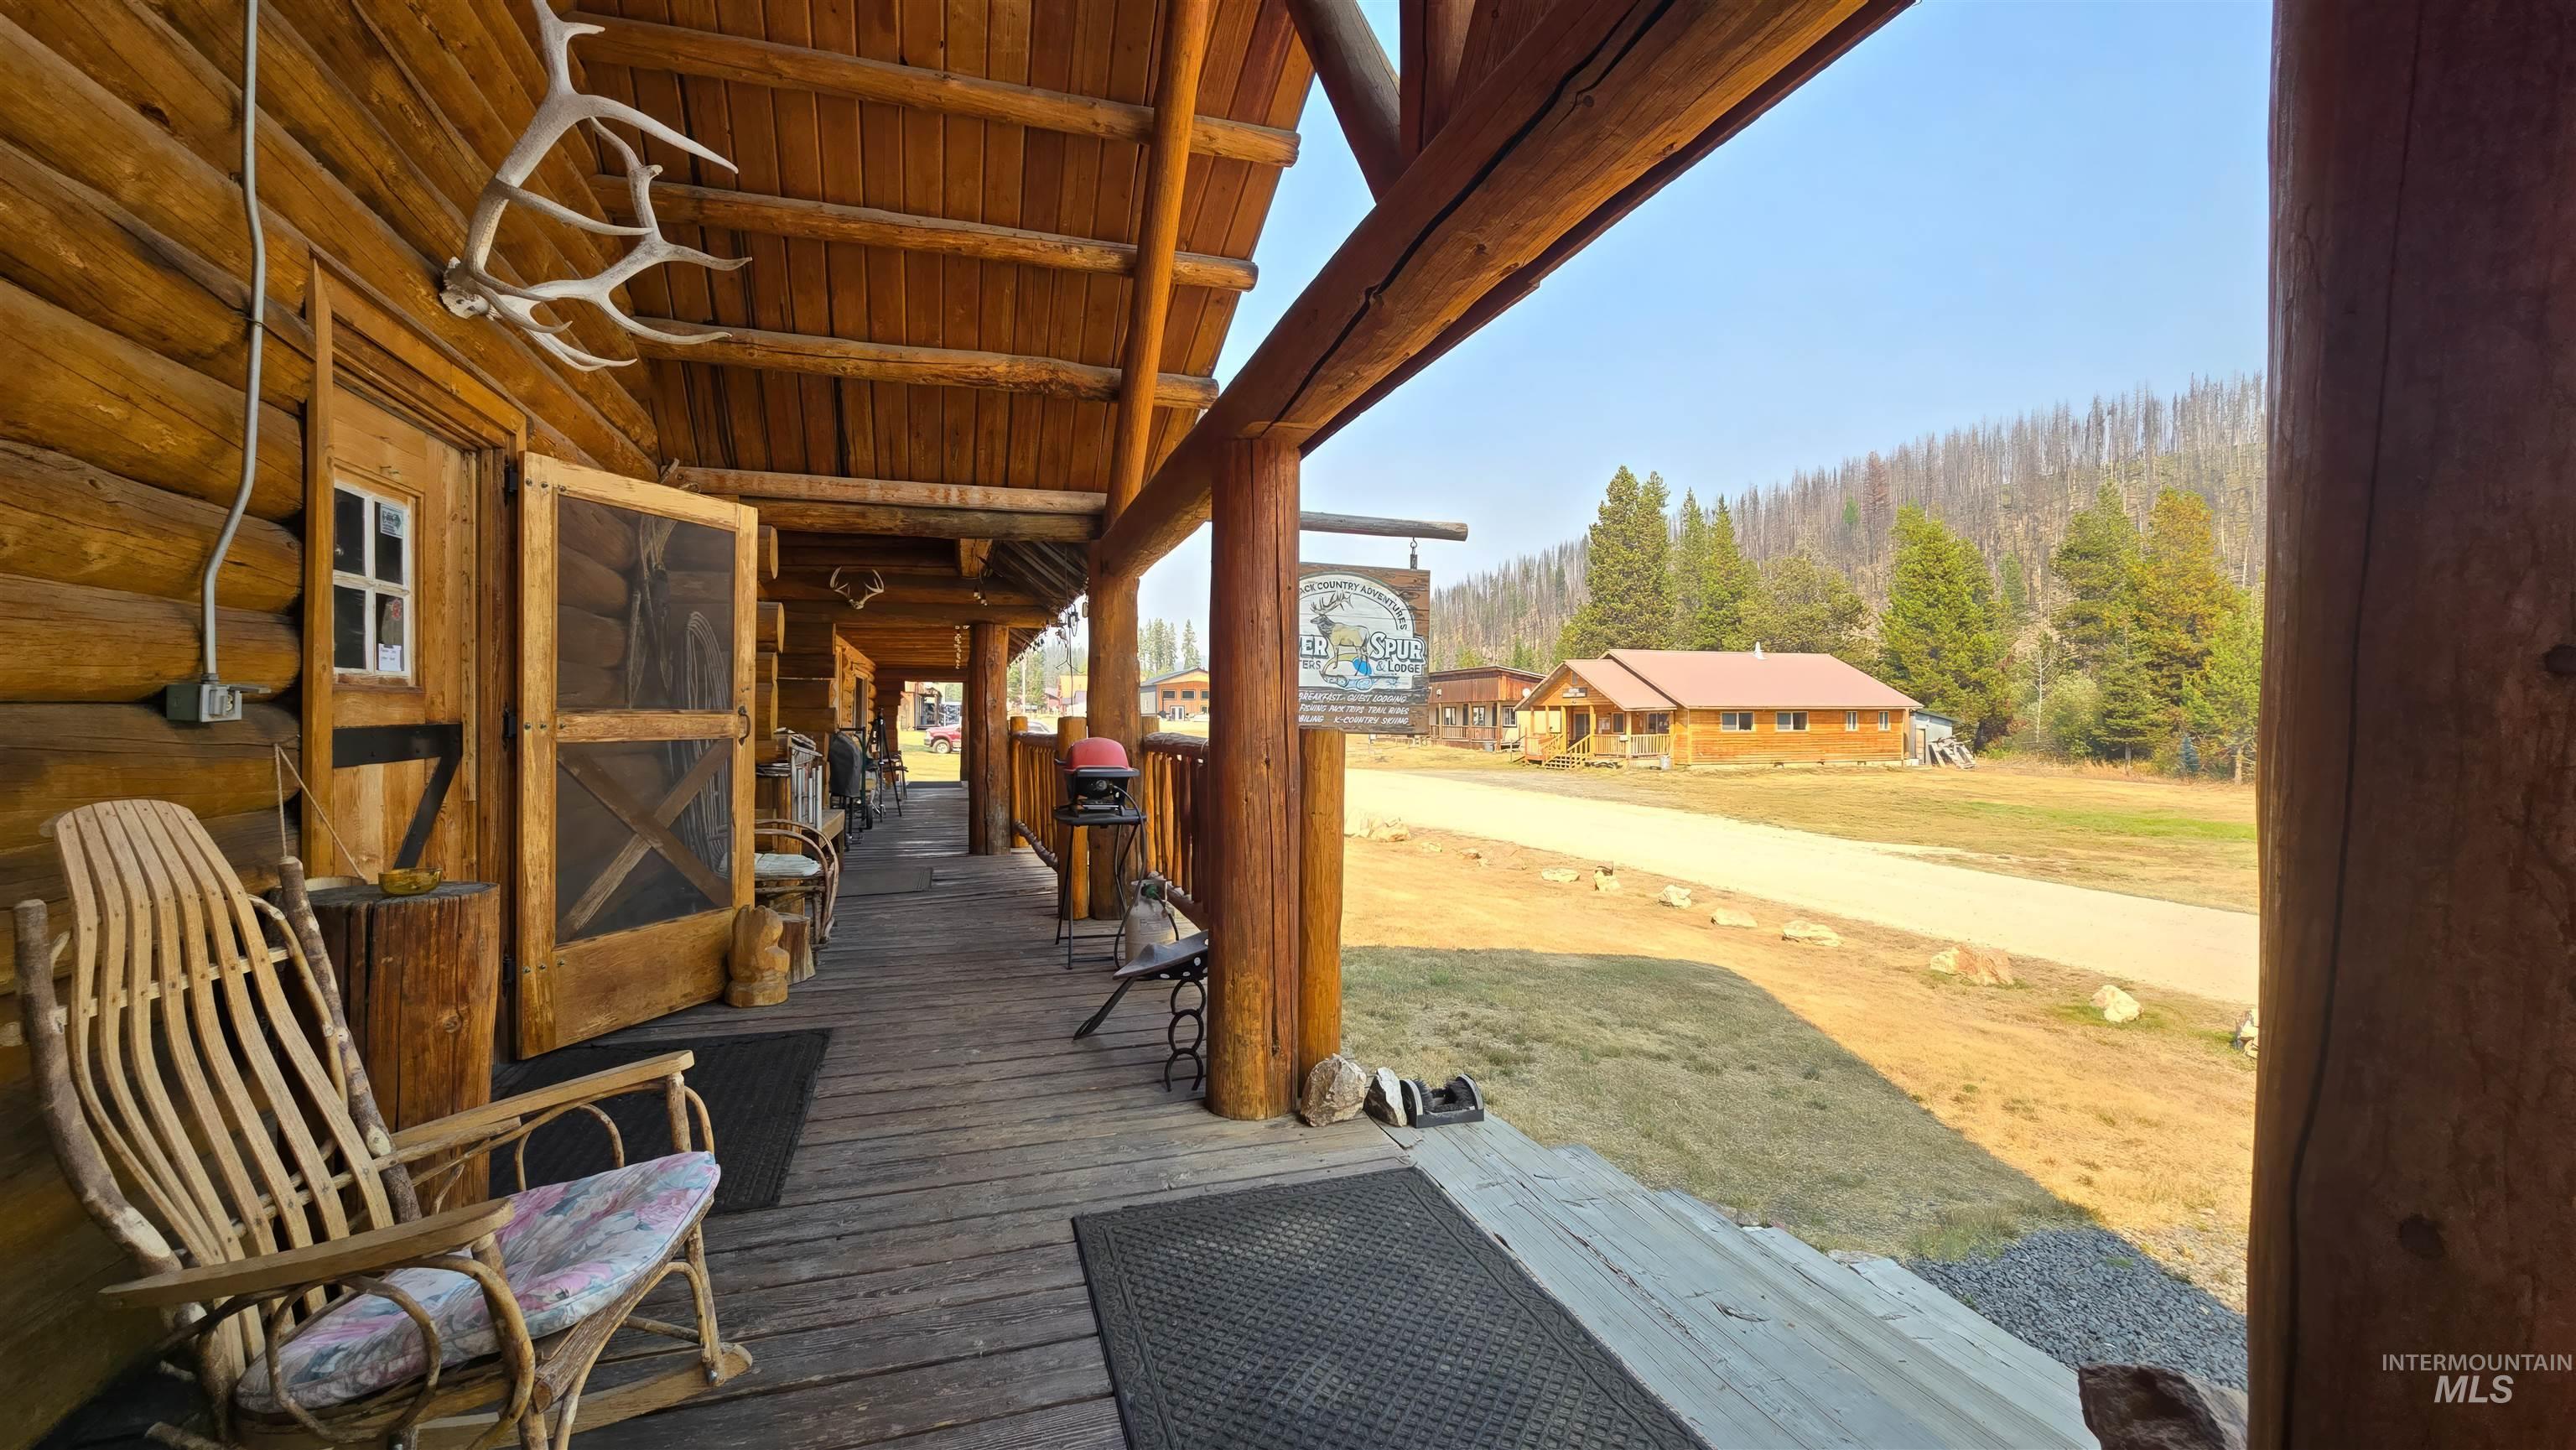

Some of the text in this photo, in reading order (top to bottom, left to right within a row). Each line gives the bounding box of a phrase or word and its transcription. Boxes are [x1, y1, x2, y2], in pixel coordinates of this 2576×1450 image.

[1300, 581, 1408, 631] ACK COUNTRY ADVENTURES
[1301, 631, 1424, 663] ER SPUR
[1301, 660, 1420, 673] ERS & LODGE
[1347, 694, 1370, 702] GUEST
[1300, 704, 1327, 712] FISHING
[1299, 715, 1324, 723] BILING
